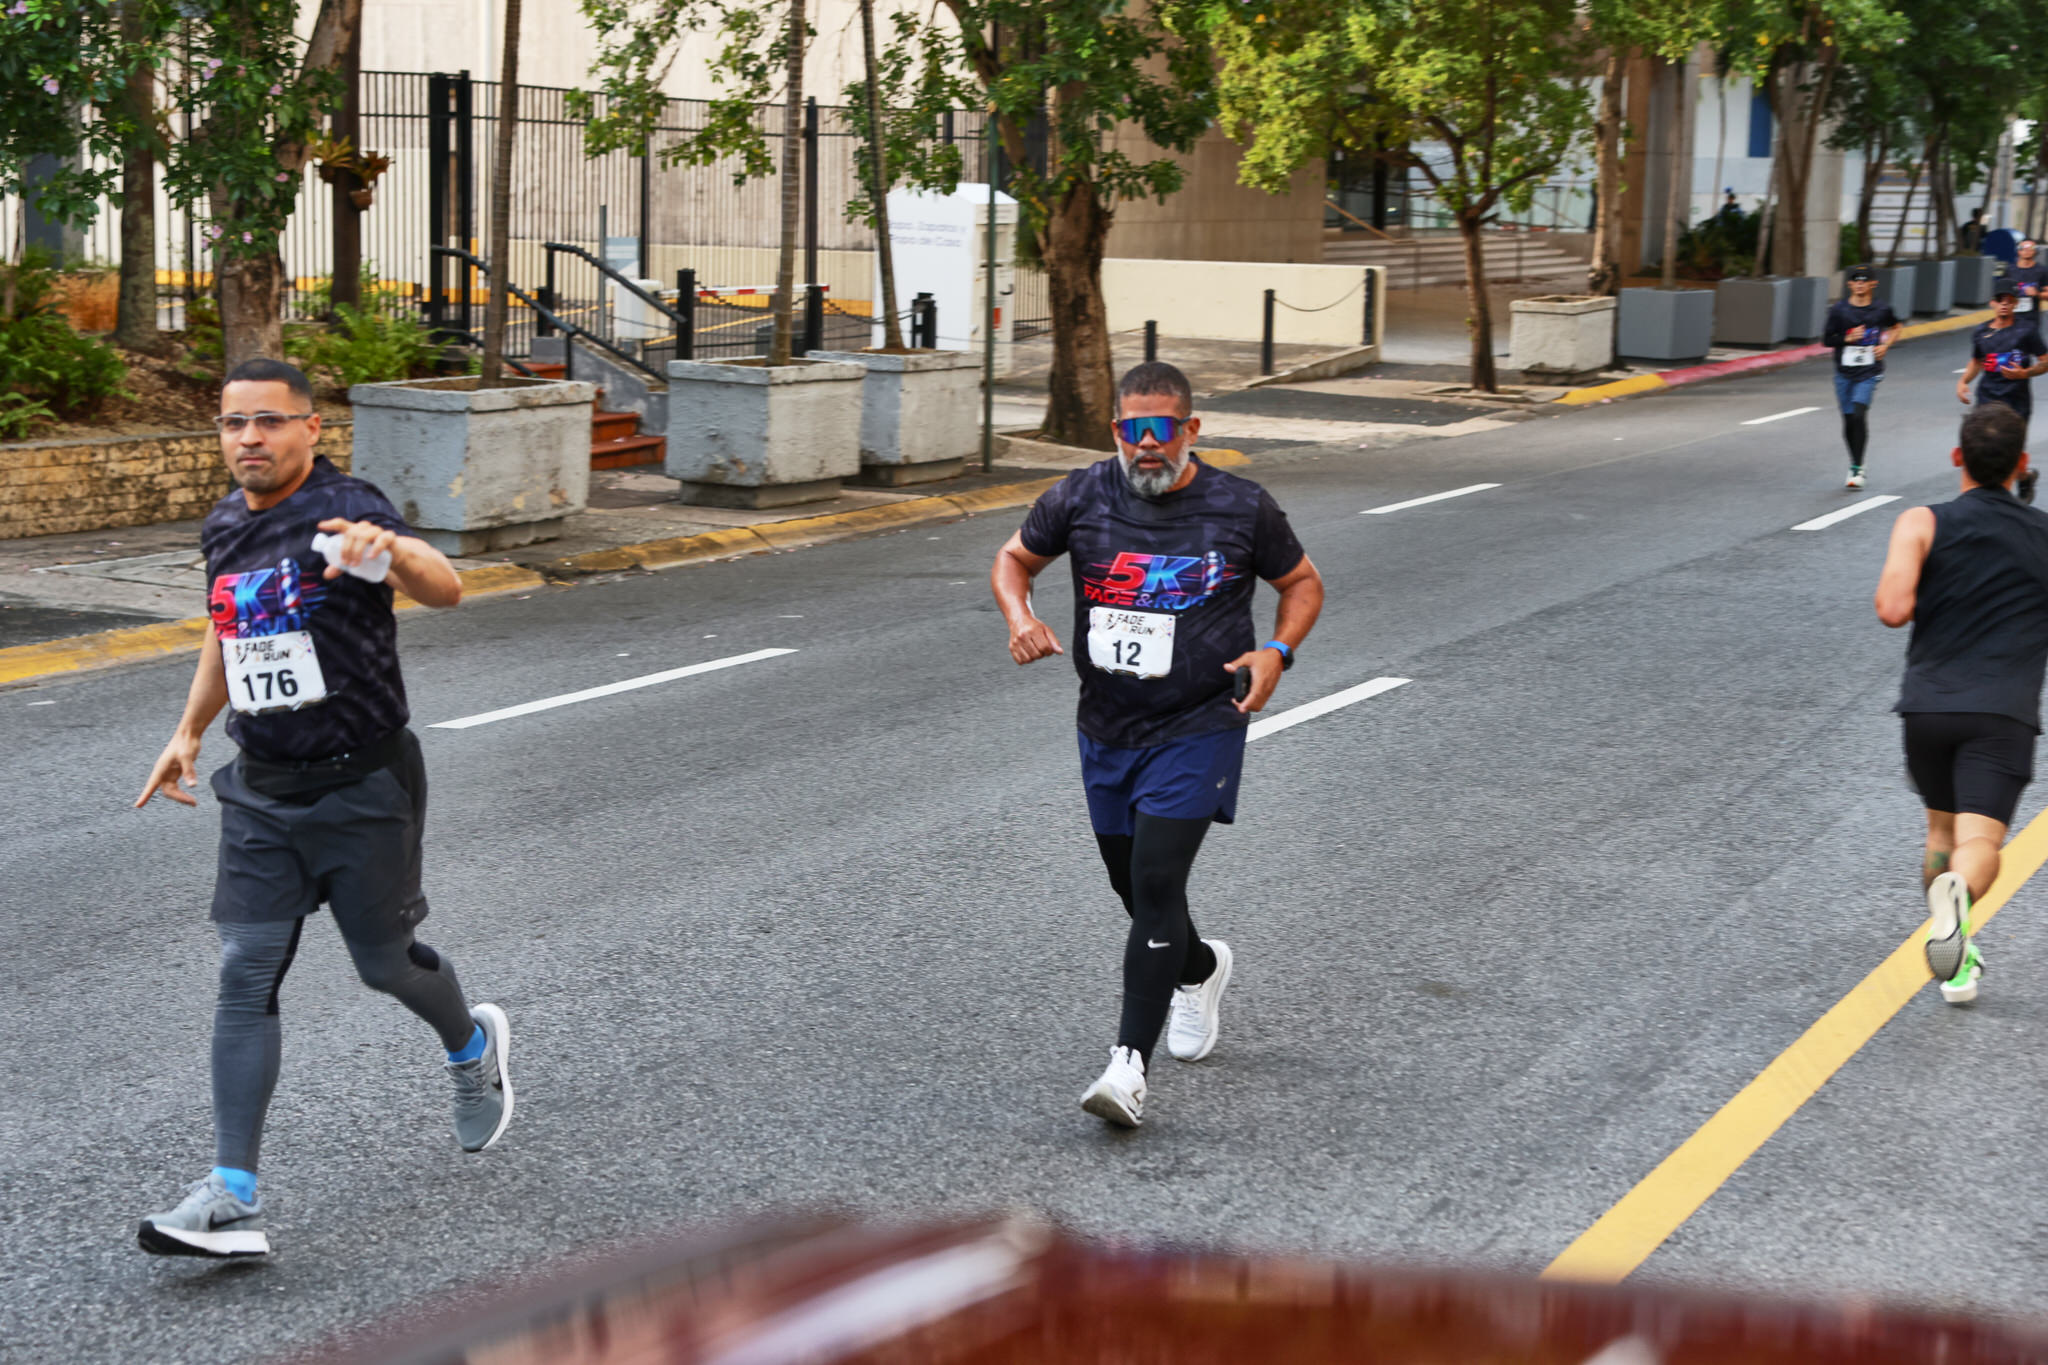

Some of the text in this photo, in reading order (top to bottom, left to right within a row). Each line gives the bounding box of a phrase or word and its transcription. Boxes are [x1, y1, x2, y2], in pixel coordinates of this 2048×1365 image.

[1101, 551, 1202, 594] 5K
[211, 568, 275, 623] 5K
[1084, 583, 1138, 606] FADE
[1135, 593, 1154, 608] &
[1116, 613, 1146, 626] FADE
[1129, 625, 1155, 636] RUN
[245, 640, 275, 653] FADE
[263, 649, 291, 662] RUN
[1112, 639, 1142, 666] 12
[242, 669, 298, 702] 176
